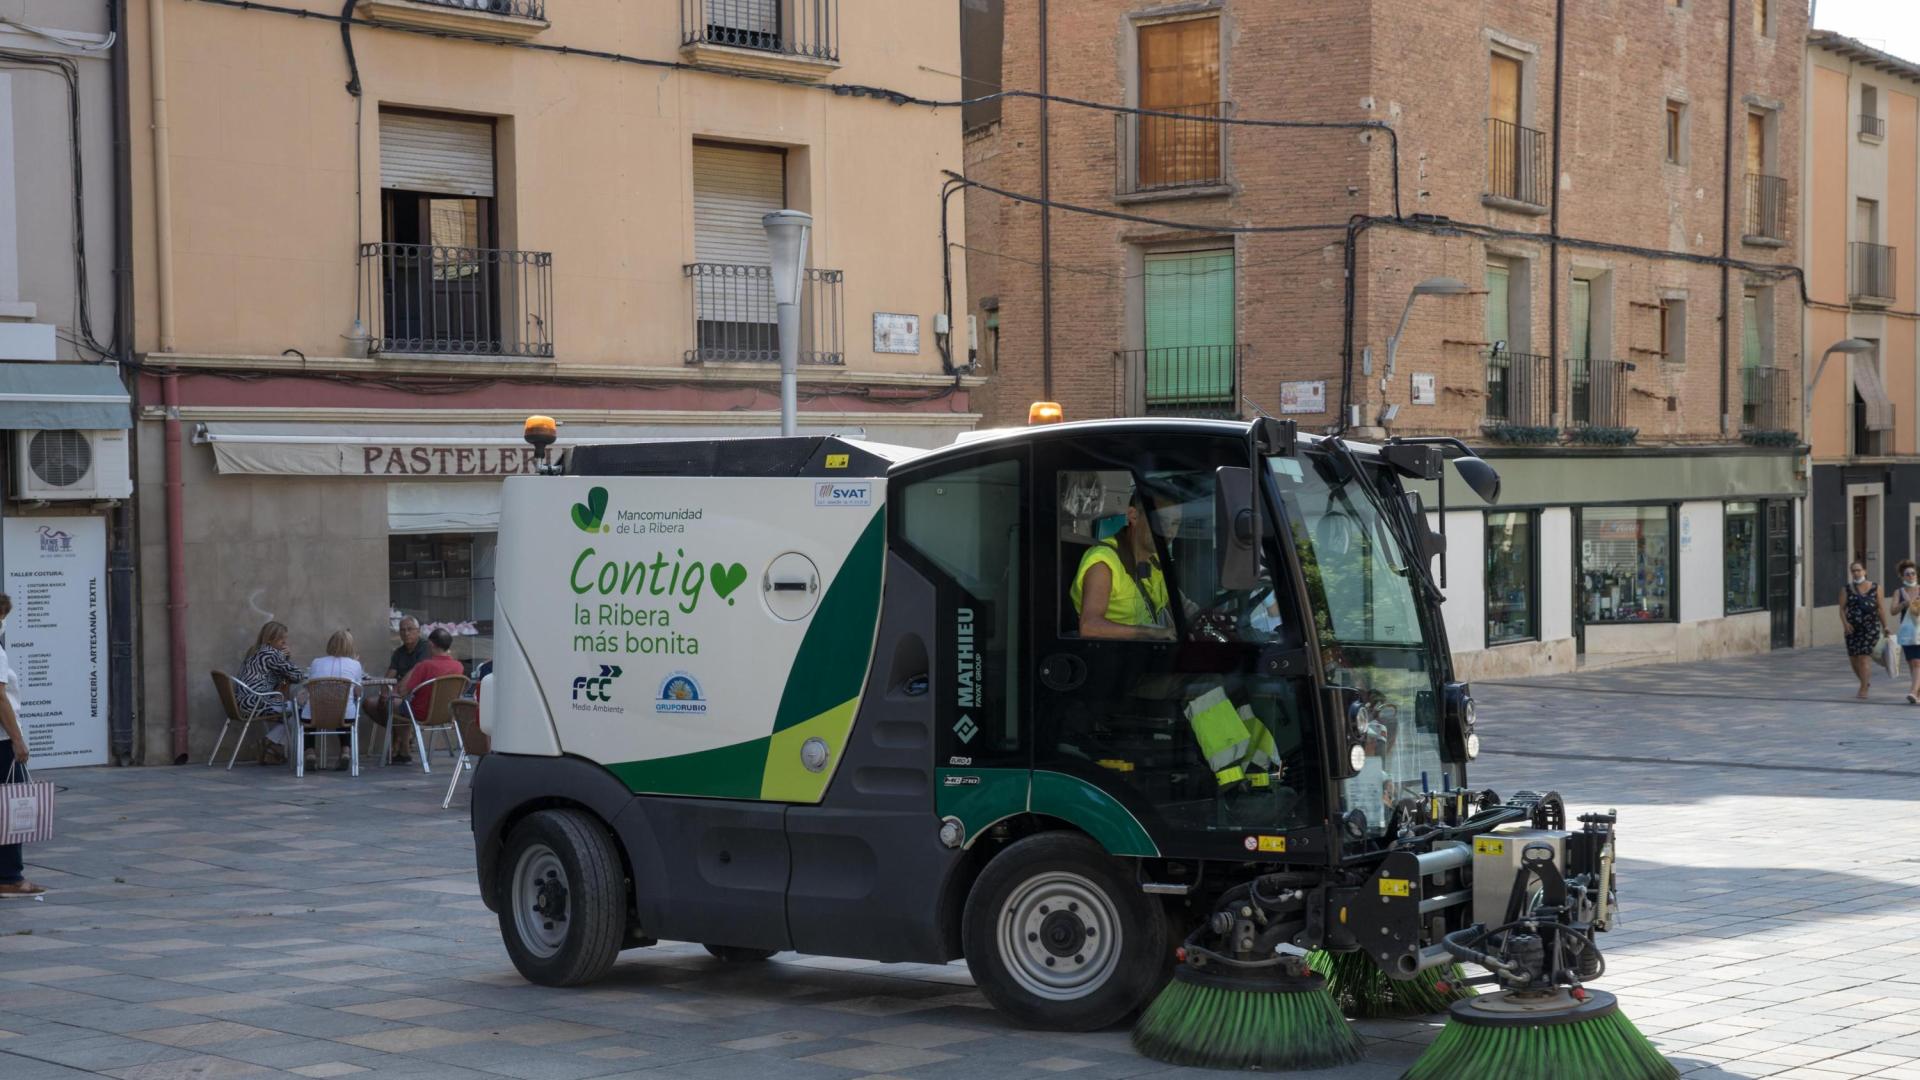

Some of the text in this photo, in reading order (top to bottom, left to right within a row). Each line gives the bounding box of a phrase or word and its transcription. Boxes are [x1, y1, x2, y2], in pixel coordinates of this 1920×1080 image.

[362, 446, 573, 474] PASTELERI
[833, 489, 866, 498] SVAT
[617, 508, 703, 520] Mancomunidad
[616, 522, 685, 534] de La Ribera
[574, 603, 670, 626] la Ribera
[88, 610, 97, 664] ARTESANÍA
[574, 630, 699, 654] más bonita
[958, 608, 974, 707] MATHIEU
[573, 677, 612, 702] FCC
[572, 703, 625, 714] Medio Ambiente
[655, 703, 707, 712] GRUPORUBIO
